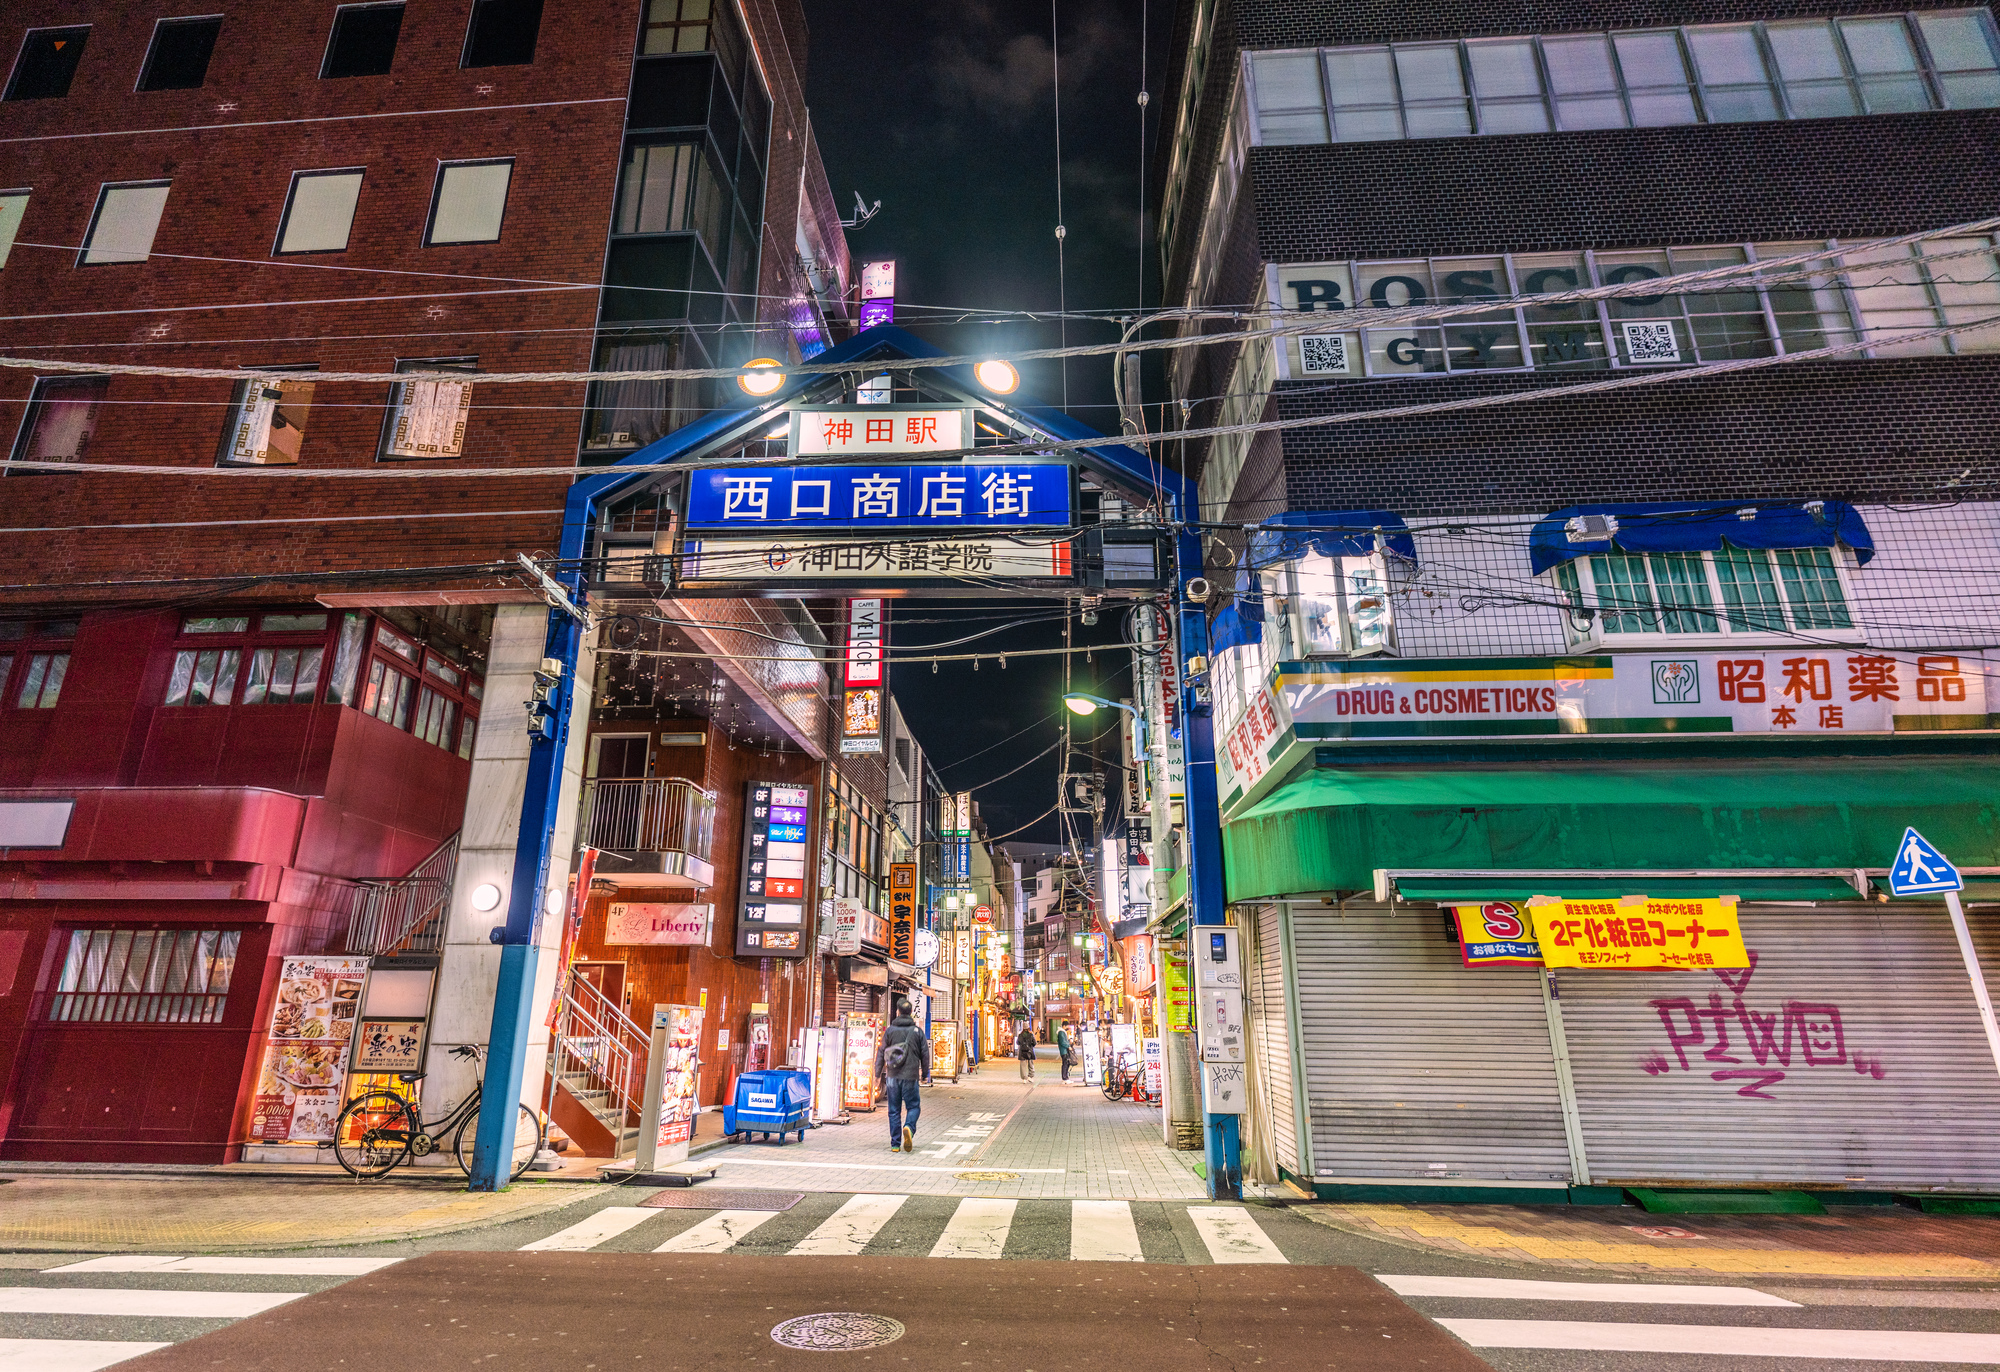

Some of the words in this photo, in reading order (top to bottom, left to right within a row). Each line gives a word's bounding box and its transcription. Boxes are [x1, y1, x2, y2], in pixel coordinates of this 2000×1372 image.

[1386, 332, 1590, 366] GYM
[824, 417, 938, 446] 神田駅
[722, 470, 1034, 520] 西口商店街
[801, 542, 993, 573] 神田外語学院
[1717, 655, 1967, 705] 昭和薬品
[1336, 689, 1395, 715] DRUG
[1399, 696, 1412, 714] &
[1415, 687, 1556, 714] COSMETICKS
[1772, 705, 1843, 729] 本店
[1227, 689, 1277, 772] 昭和薬品
[756, 790, 769, 802] 6F
[754, 807, 767, 818] 6F
[959, 795, 968, 827] ほぐし
[752, 834, 766, 847] 5F
[1128, 828, 1140, 856] 古田島
[751, 862, 764, 874] 4F
[749, 880, 762, 893] 3F
[611, 906, 626, 916] 4F
[1481, 902, 1538, 940] S
[1564, 903, 1616, 915] 資生堂化粧品
[1646, 903, 1703, 915] カネボウ化粧品
[651, 918, 704, 935] Liberty
[747, 933, 760, 946] B1
[893, 904, 911, 960] 宇奈とと
[1549, 917, 1730, 949] 2F化粧品コーナー
[1473, 943, 1541, 956] お得なセール
[1578, 952, 1632, 964] 花王ソフィーナ
[1659, 952, 1715, 965] コーセー化粧品
